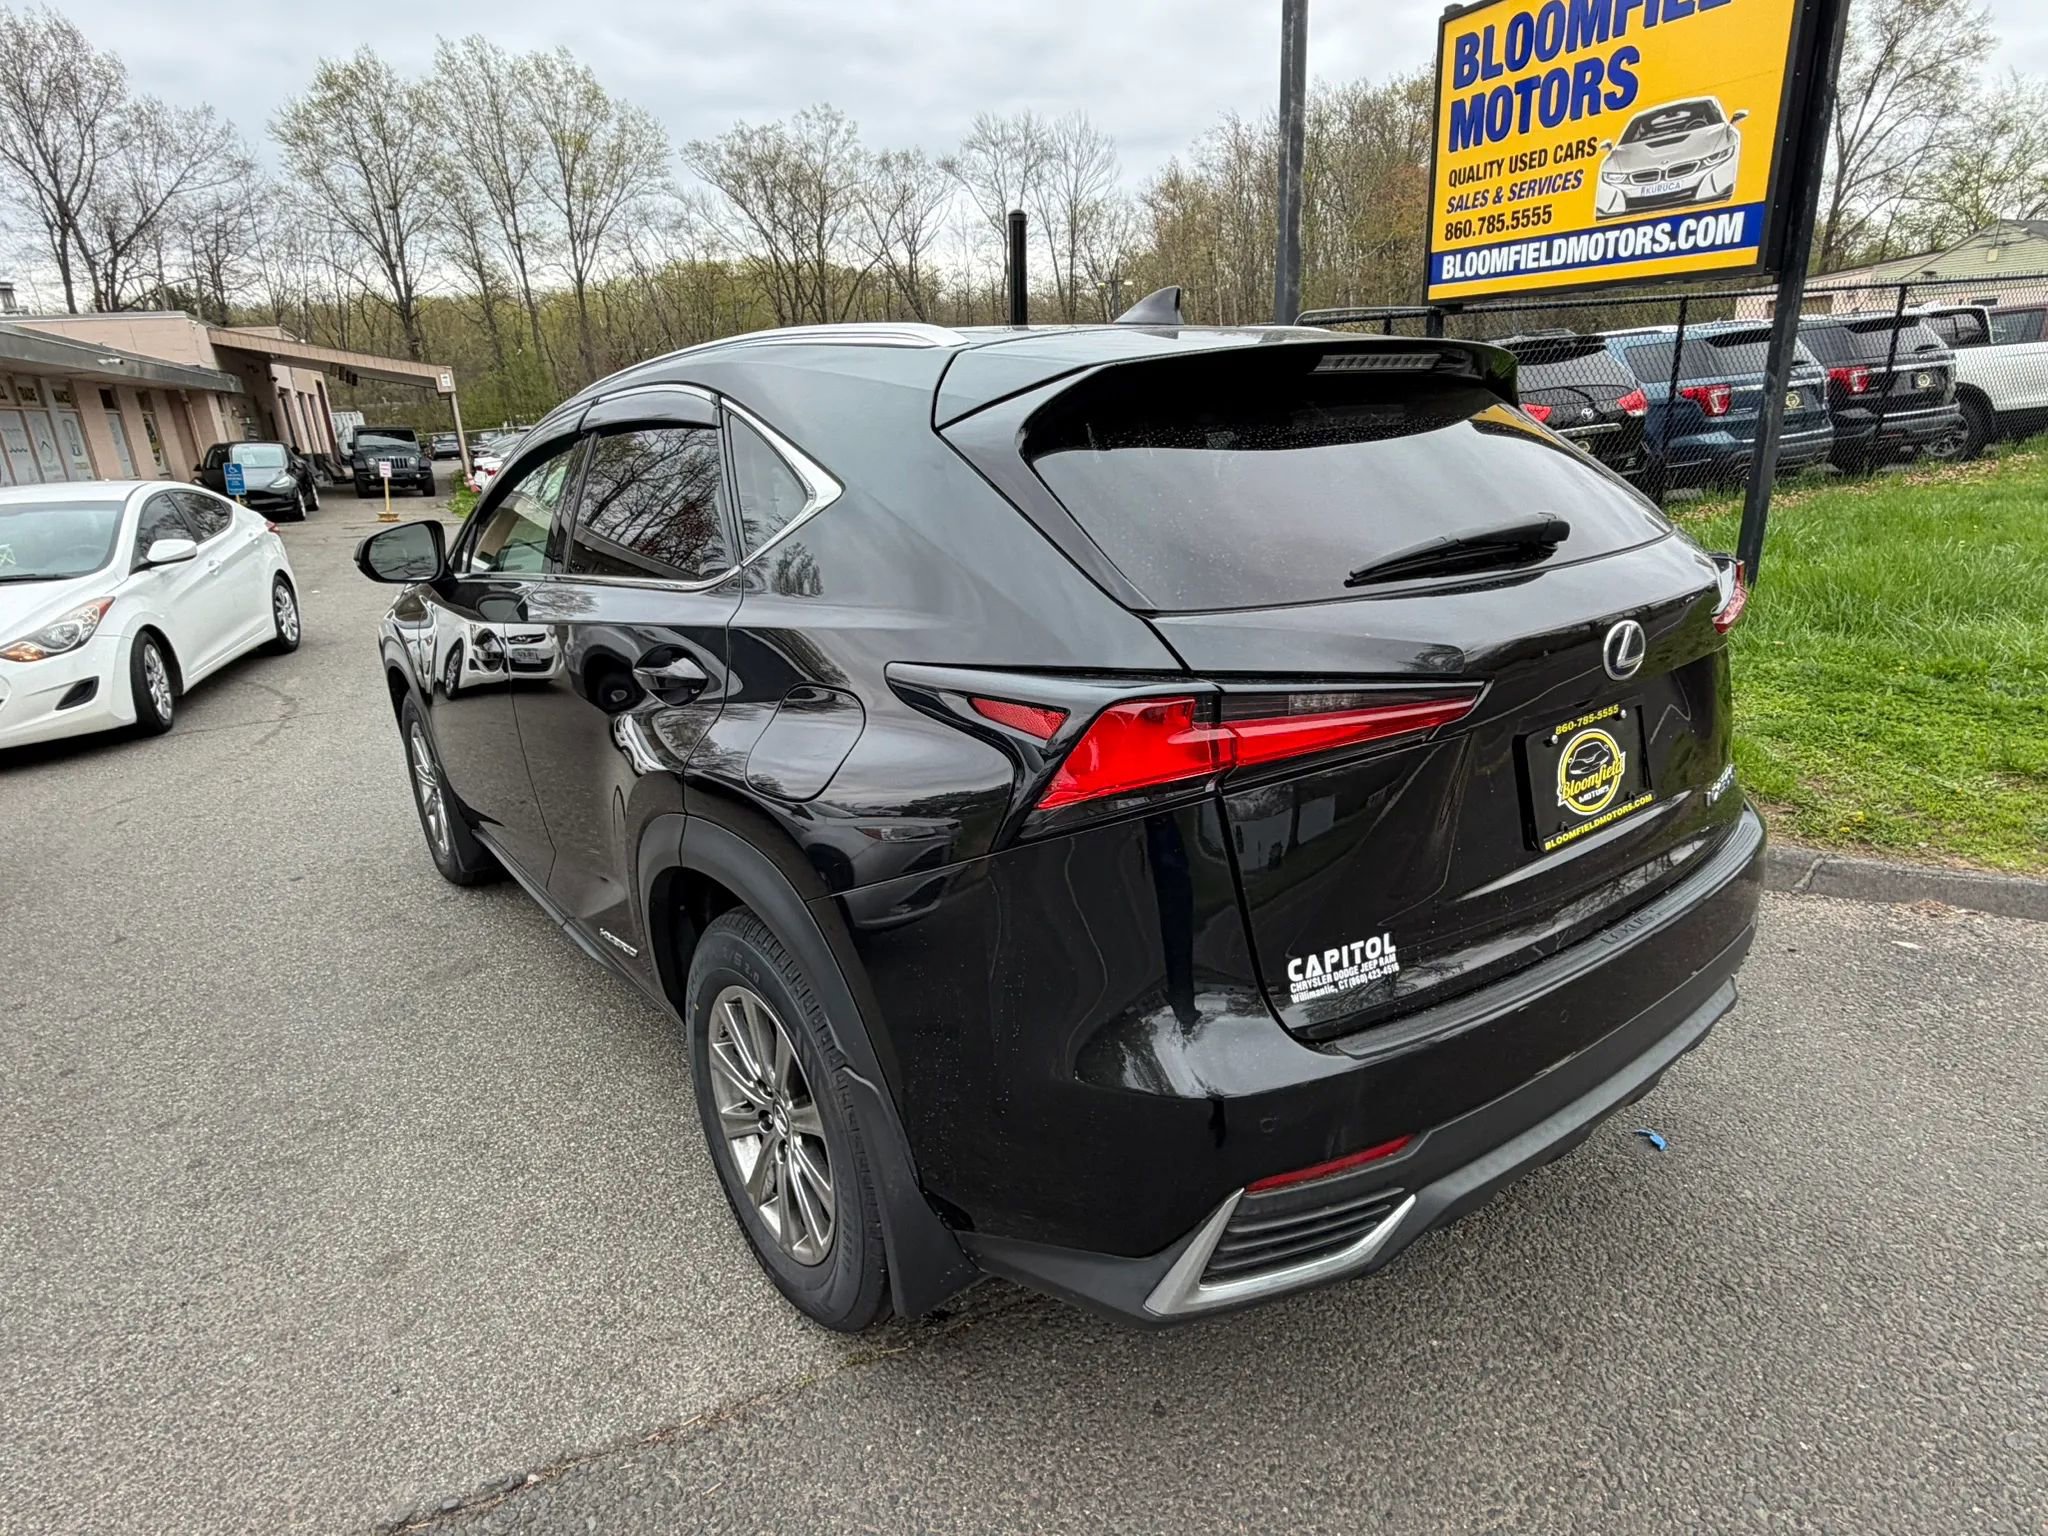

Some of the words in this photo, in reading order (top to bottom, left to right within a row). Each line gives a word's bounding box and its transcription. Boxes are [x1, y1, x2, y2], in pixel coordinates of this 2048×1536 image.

[1453, 0, 1732, 90] BLOOMF
[1448, 46, 1640, 153] MOTORS
[1448, 158, 1504, 188] QUALITY
[1508, 148, 1548, 175] USED
[1553, 136, 1598, 164] CARS
[1446, 189, 1490, 215] SALES
[1492, 186, 1504, 205] &
[1507, 169, 1584, 202] SERVICES
[1441, 211, 1745, 280] BLOOMFIELDMOTORS.COM
[1444, 204, 1552, 241] 860.785.5555
[1555, 704, 1619, 735] 860-785-5555
[1562, 759, 1622, 800] Bloomfield
[1578, 784, 1610, 803] MOTORS
[1544, 793, 1653, 851] BLOOMFIELDMOTORS.COM
[1287, 932, 1397, 982] CAPITOL
[1290, 972, 1333, 993] CHRYSLER
[1333, 965, 1359, 981] DODGE
[1360, 959, 1378, 973] JEEP
[1379, 953, 1397, 967] RAM
[1290, 984, 1339, 1004] Willimantic,
[1338, 979, 1349, 990] CT
